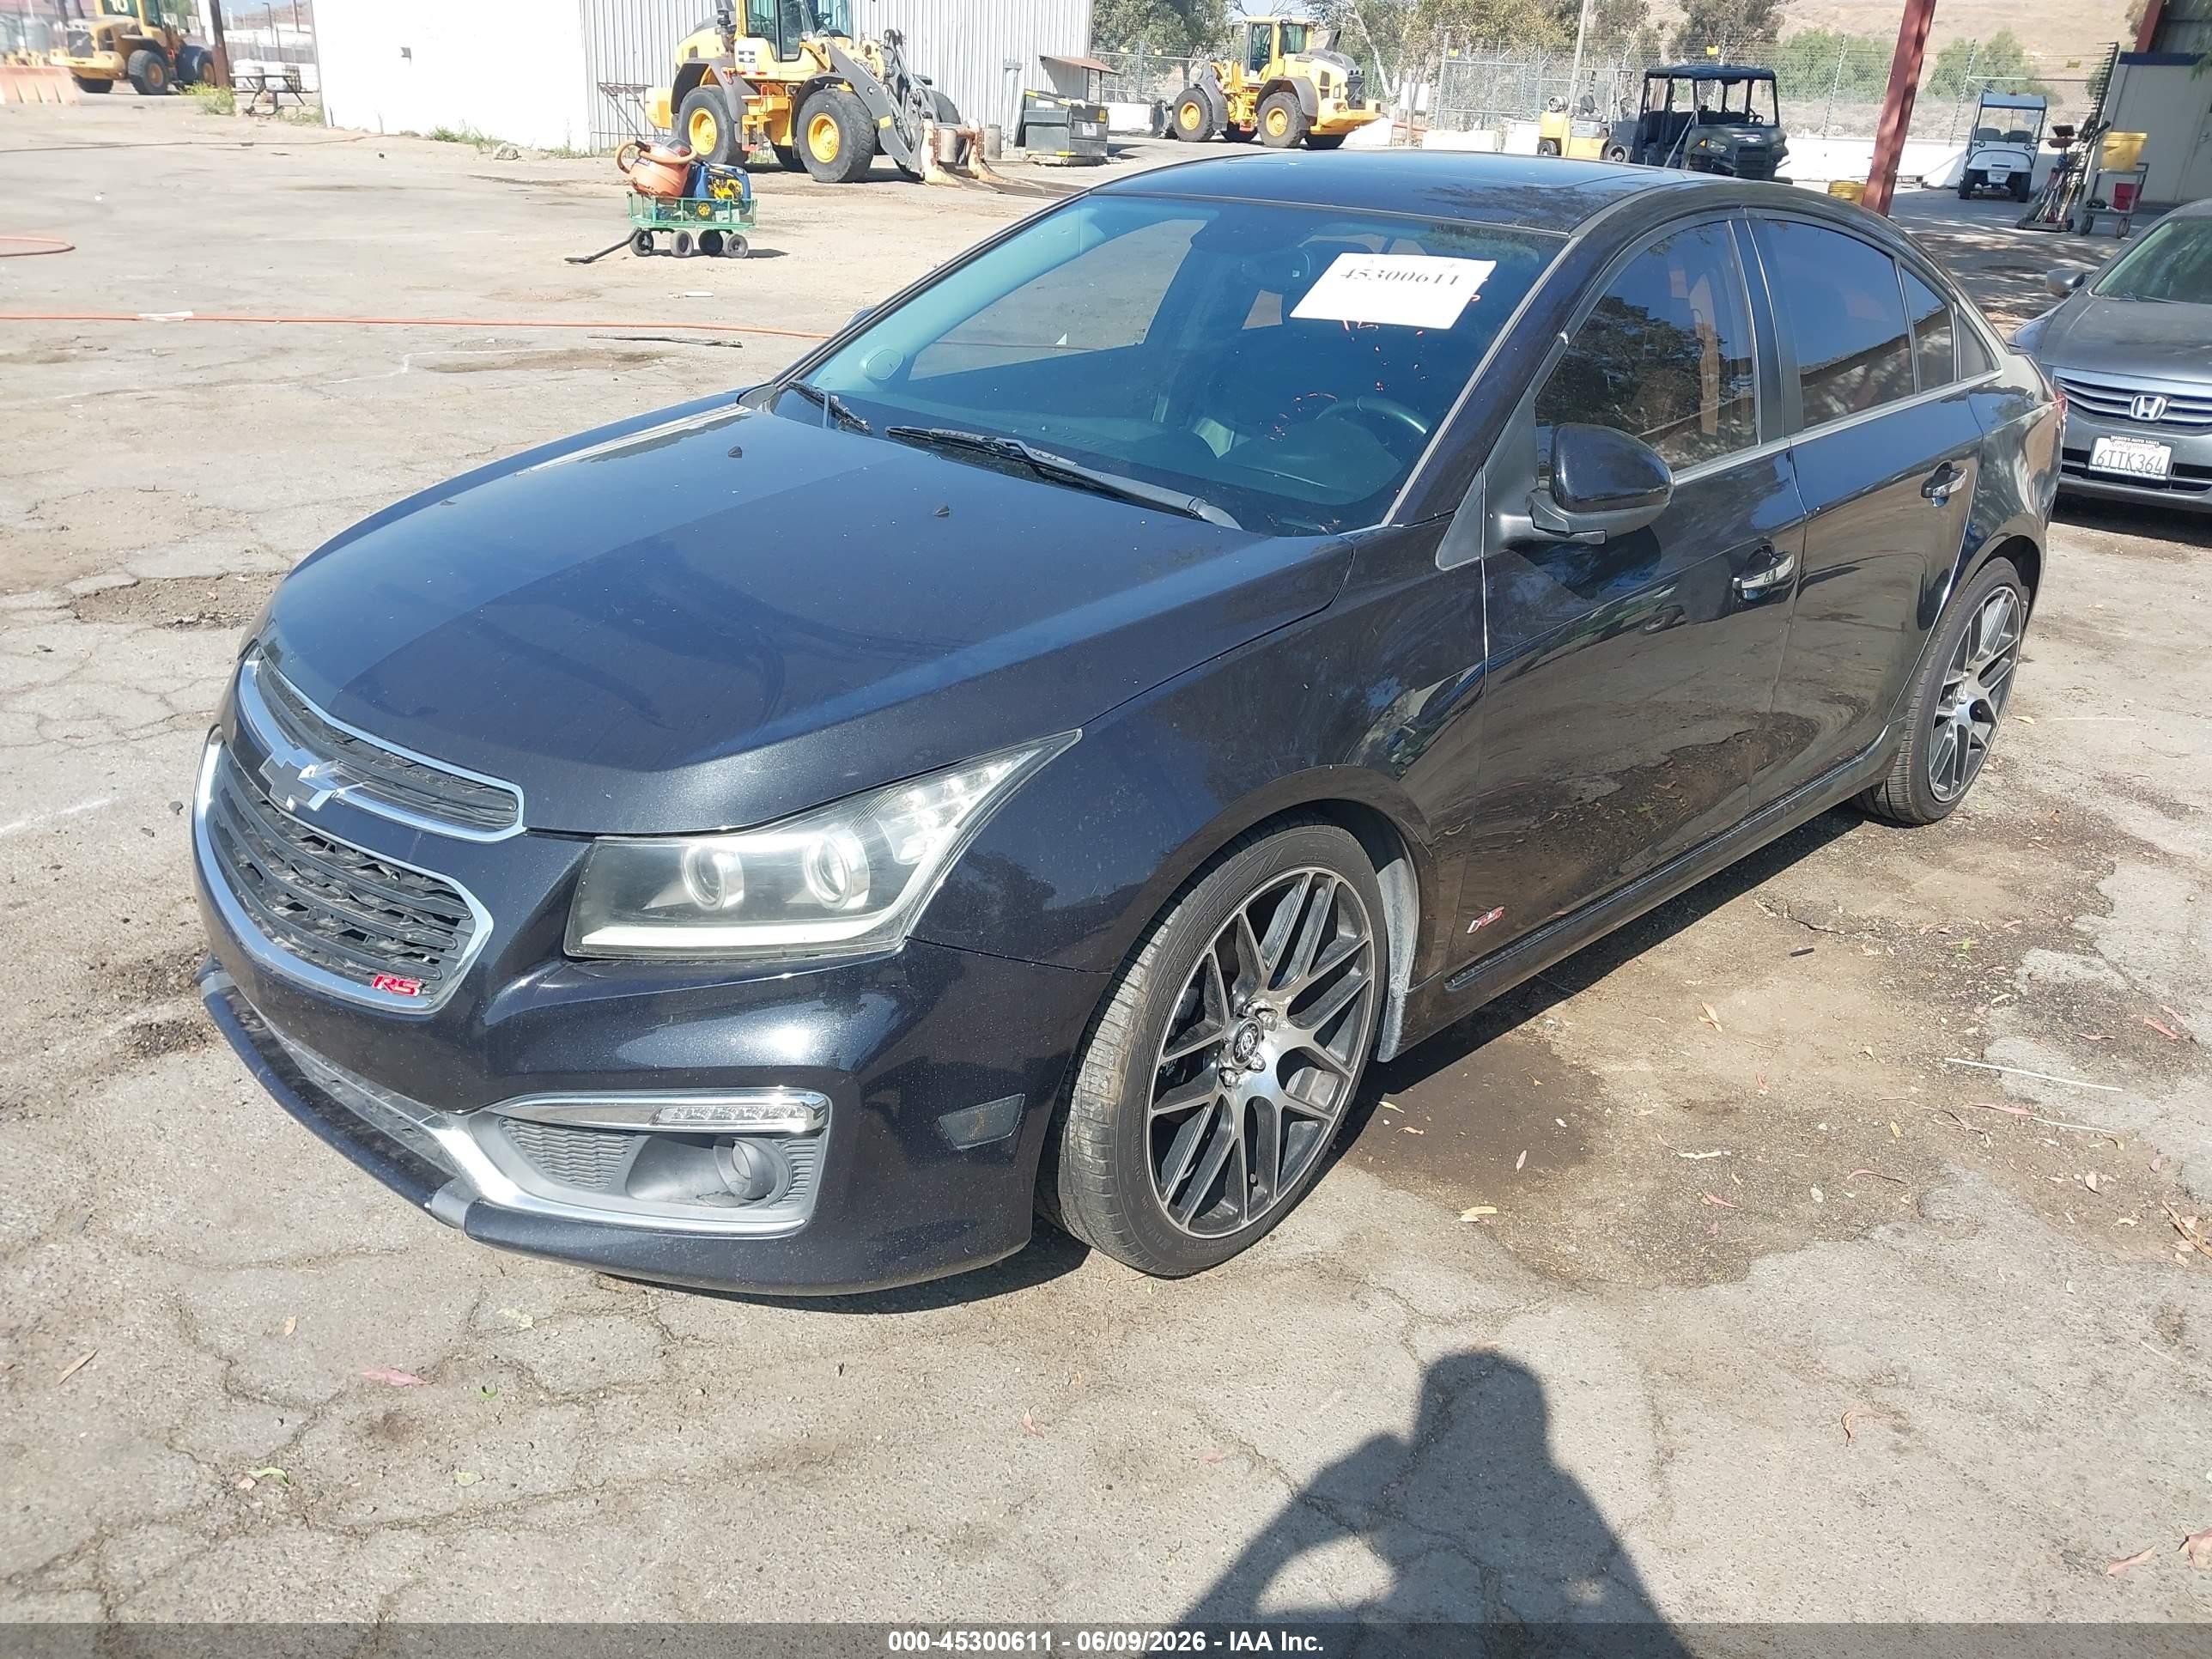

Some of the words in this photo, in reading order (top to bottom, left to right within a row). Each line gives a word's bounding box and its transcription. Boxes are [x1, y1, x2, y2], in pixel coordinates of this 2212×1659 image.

[1340, 268, 1460, 286] 45300611
[2096, 449, 2164, 475] 6TTK364
[372, 974, 420, 996] RS
